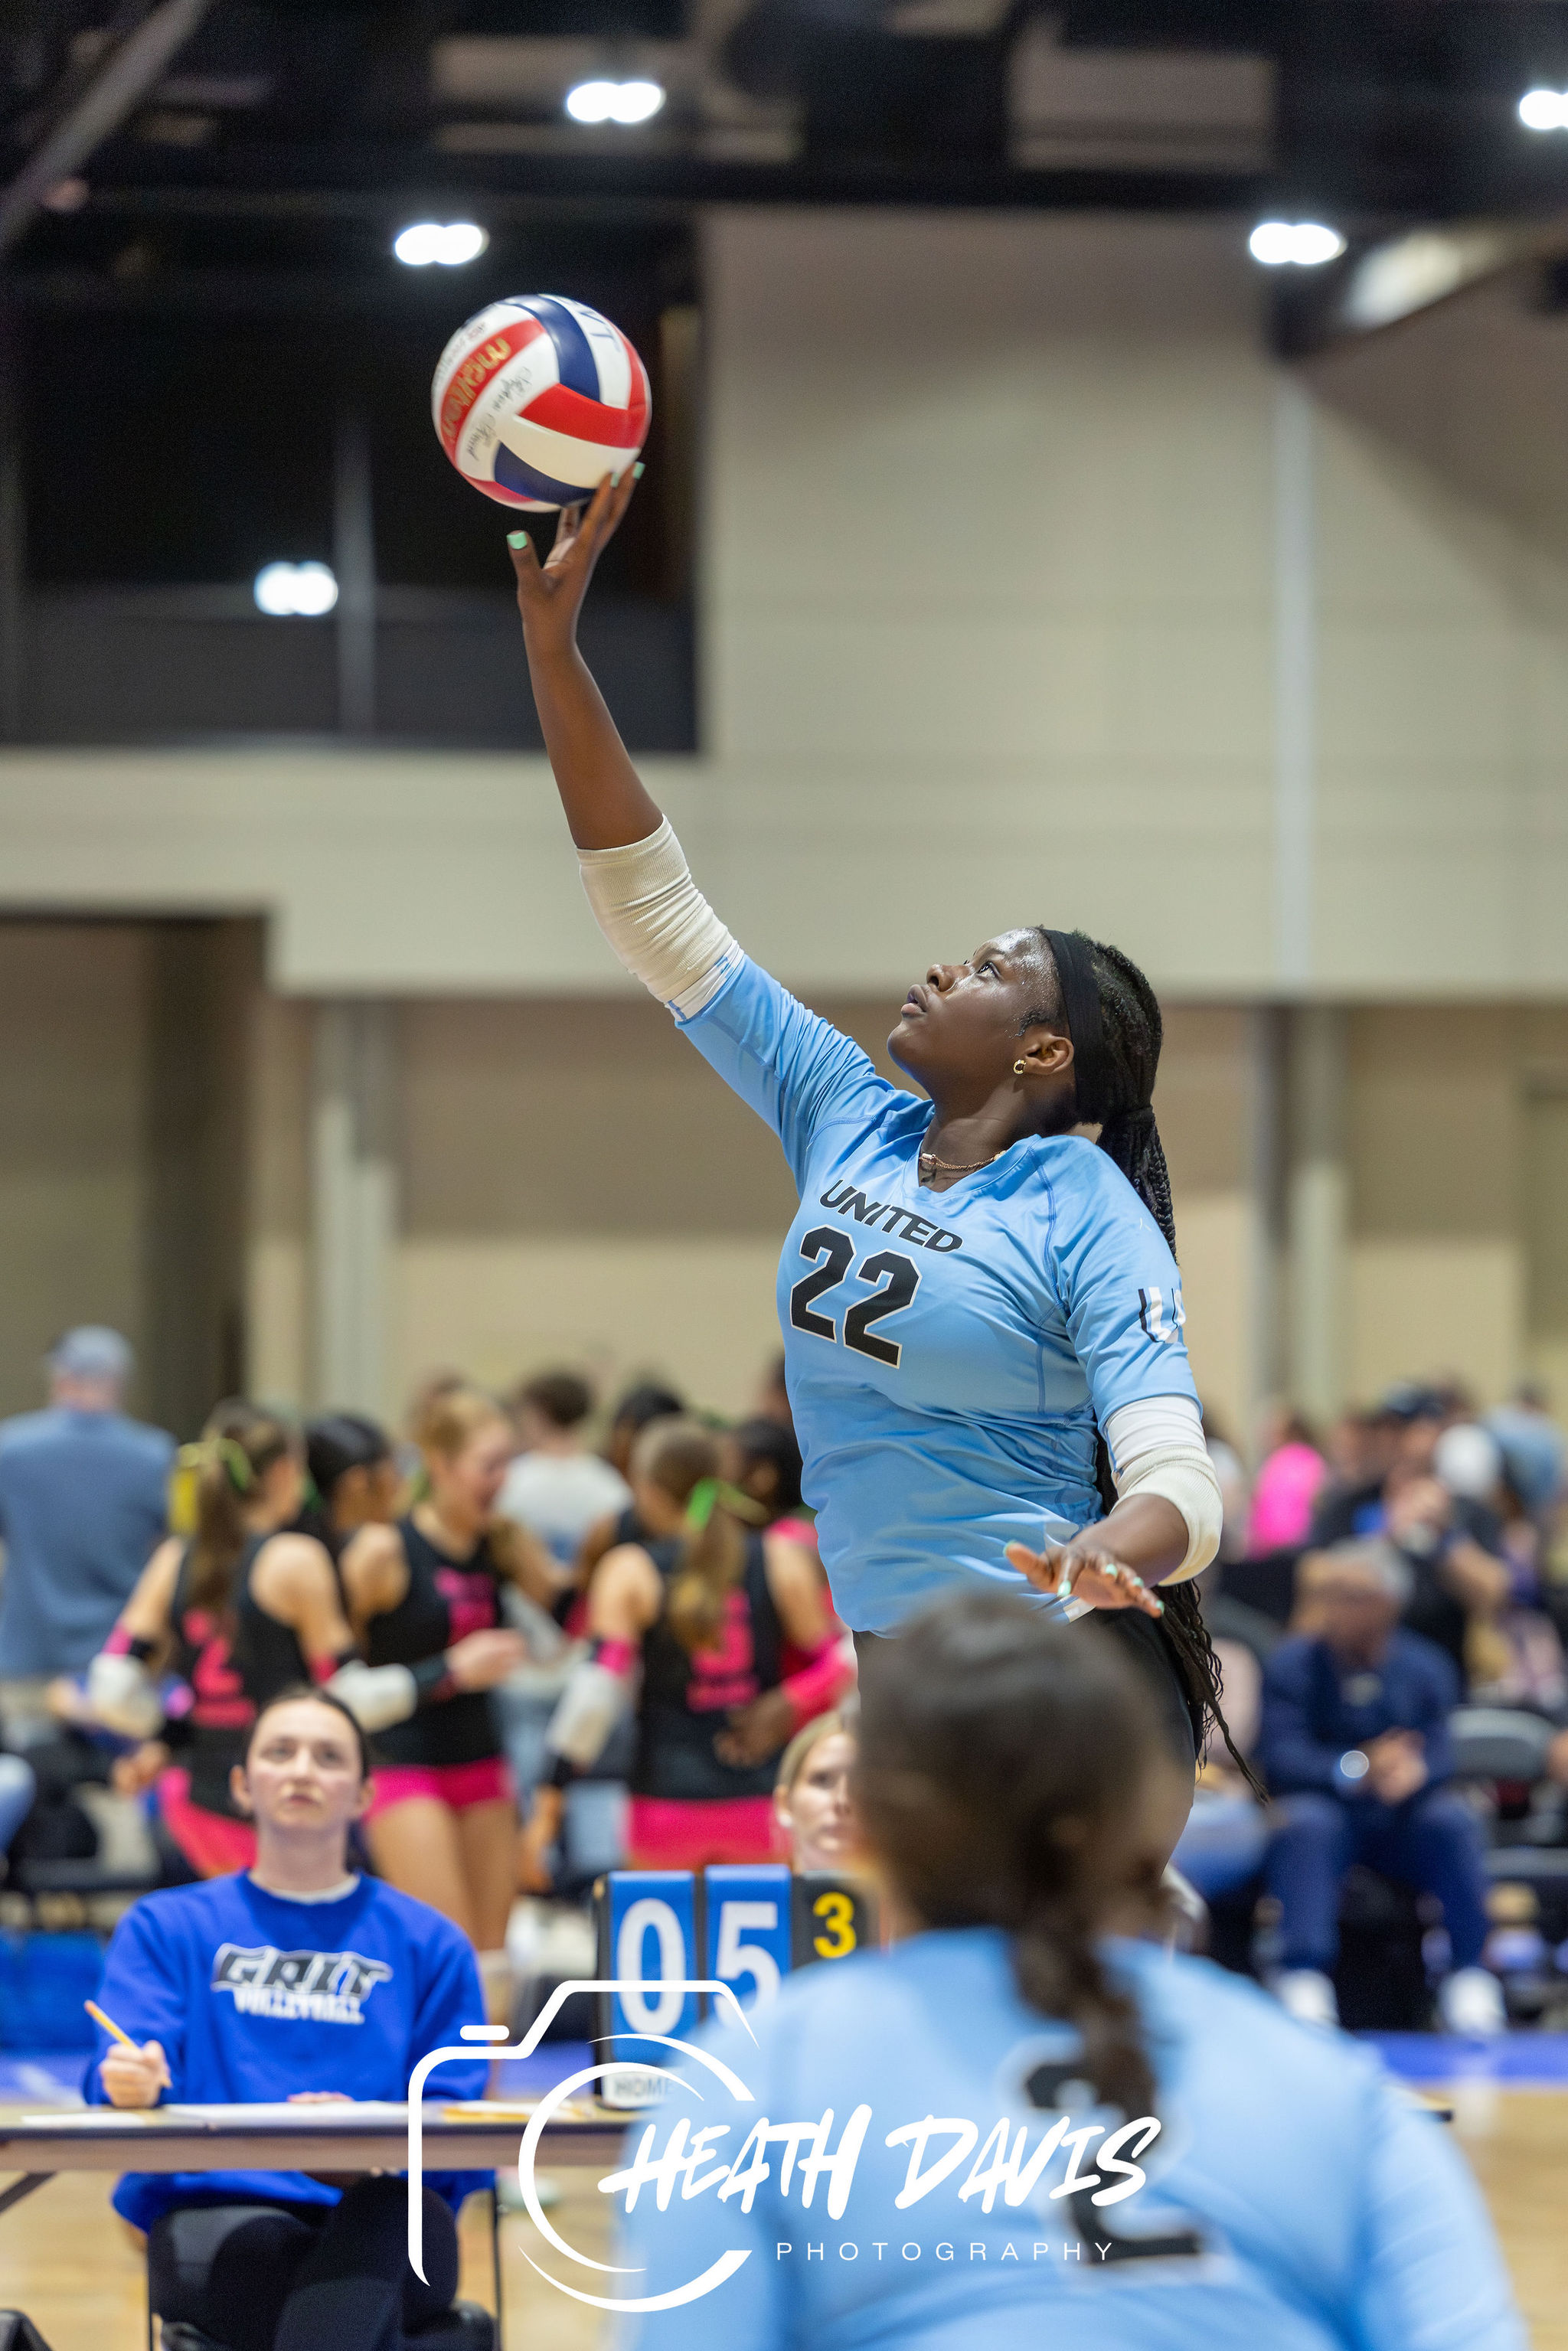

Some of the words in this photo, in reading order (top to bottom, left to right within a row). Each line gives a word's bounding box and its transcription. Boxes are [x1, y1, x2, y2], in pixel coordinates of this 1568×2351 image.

[819, 1179, 963, 1253] UNITED
[789, 1224, 923, 1370] 22
[812, 1891, 857, 1959] 3
